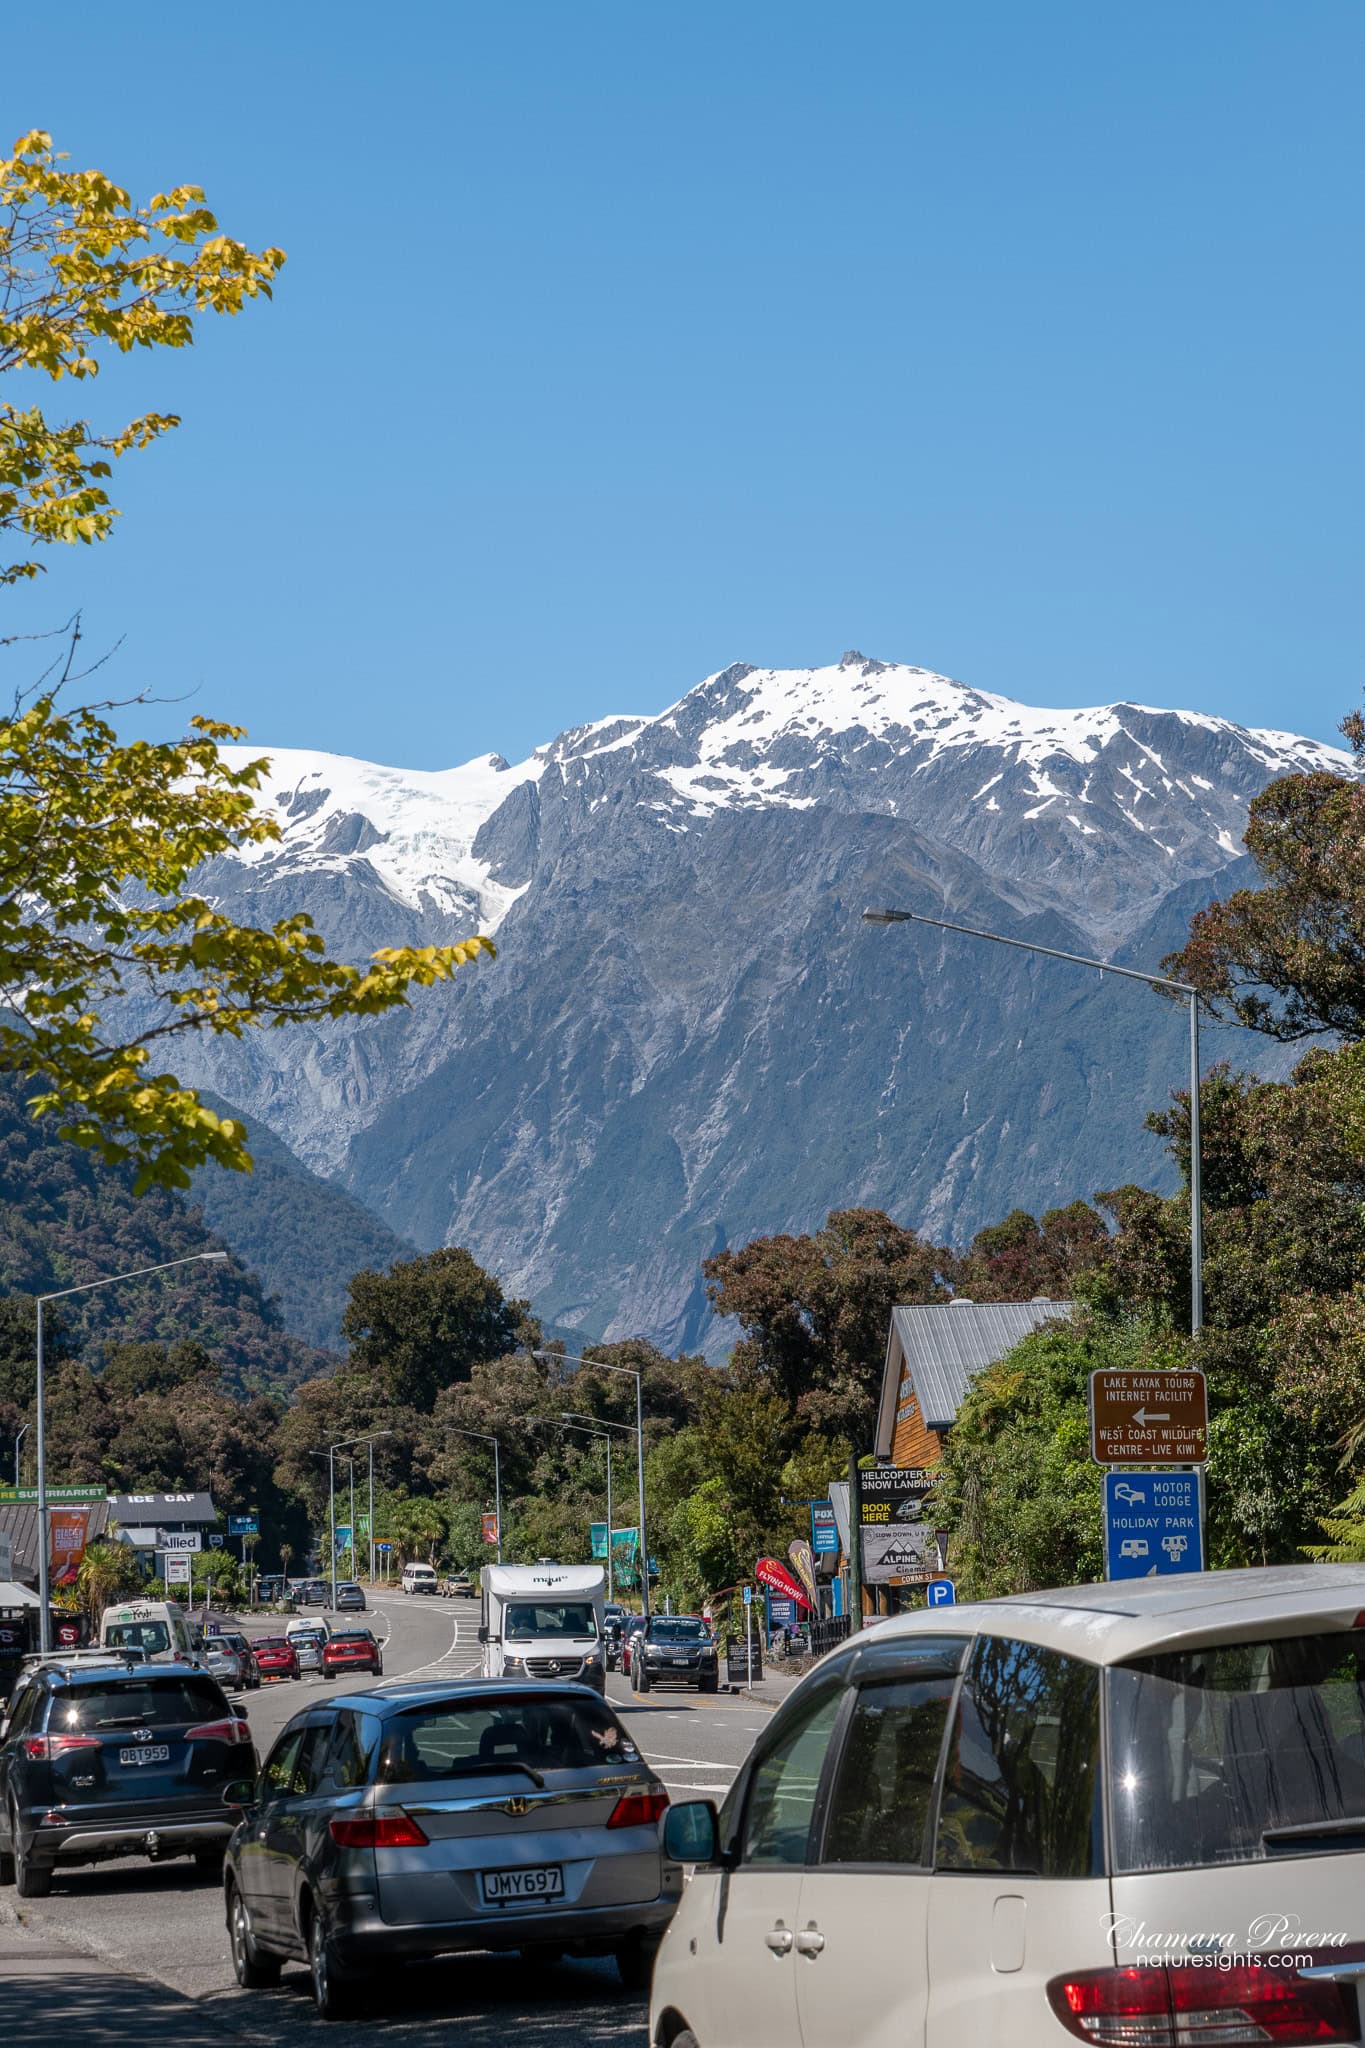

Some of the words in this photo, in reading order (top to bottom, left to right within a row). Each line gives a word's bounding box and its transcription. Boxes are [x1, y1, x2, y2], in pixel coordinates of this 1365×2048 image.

[1103, 1377, 1127, 1388] LAKE
[1133, 1377, 1160, 1388] KAYAK
[1106, 1391, 1151, 1402] INTERNET
[1155, 1391, 1193, 1402] FACILITY
[1100, 1429, 1123, 1440] WEST
[1128, 1429, 1157, 1440] COAST
[1107, 1445, 1143, 1455] CENTRE
[1152, 1444, 1172, 1455] LIVE
[1176, 1444, 1196, 1455] KIWI
[861, 1470, 924, 1480] HELICOPTER
[861, 1480, 892, 1490] SNOW
[1153, 1482, 1191, 1493] MOTOR
[127, 1495, 155, 1503] ICE
[1154, 1495, 1191, 1506] LODGE
[862, 1503, 891, 1513] BOOK
[814, 1509, 833, 1519] FOX
[862, 1512, 889, 1522] HERE
[1112, 1518, 1159, 1528] HOLIDAY
[1165, 1517, 1194, 1528] PARK
[883, 1554, 917, 1564] ALPINE
[901, 1575, 923, 1583] COWAN
[758, 1570, 785, 1588] FLYING
[783, 1583, 803, 1600] NOW!
[121, 1746, 169, 1762] QBT959
[487, 1870, 560, 1896] JMY697
